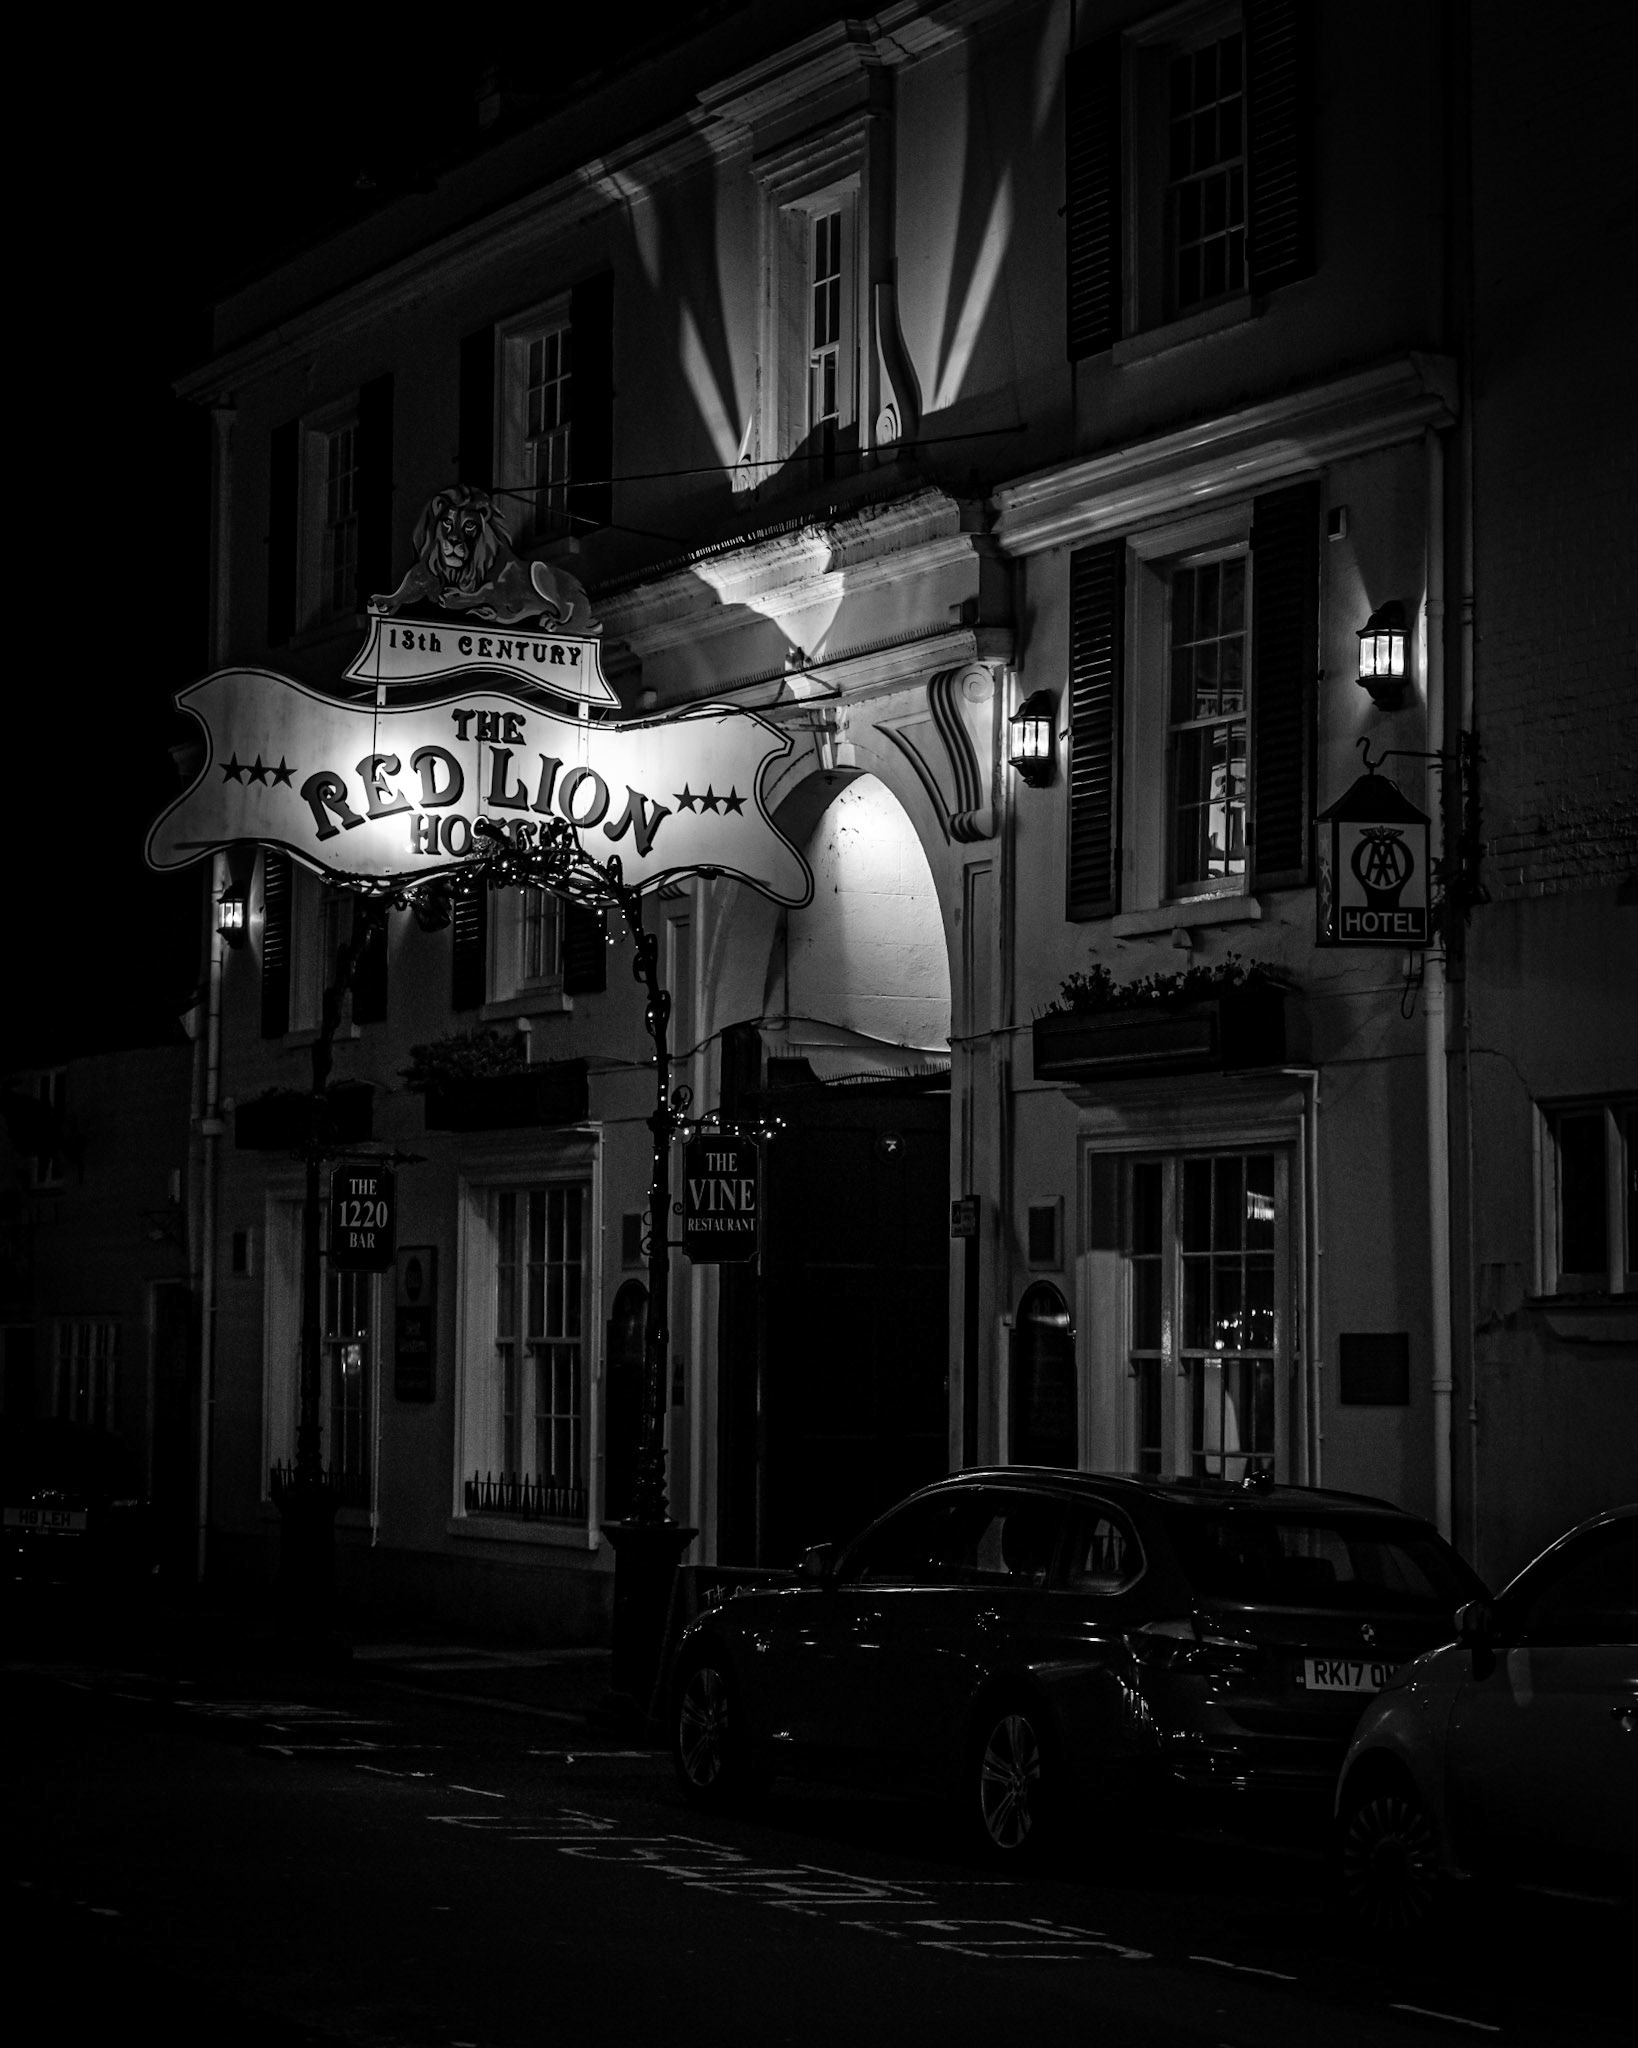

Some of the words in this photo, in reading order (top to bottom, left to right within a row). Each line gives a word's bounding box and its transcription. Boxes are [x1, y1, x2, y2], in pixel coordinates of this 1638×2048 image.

[389, 628, 442, 653] 13th
[458, 635, 582, 666] CENTURY
[451, 708, 527, 745] THE
[300, 745, 465, 841] RED
[487, 745, 673, 858] LION
[1344, 911, 1422, 934] HOTEL
[705, 1152, 738, 1172] THE
[349, 1178, 378, 1196] THE
[688, 1179, 756, 1211] VINE
[338, 1200, 389, 1229] 1220
[687, 1217, 757, 1232] RESTAURANT
[350, 1231, 376, 1249] BAR
[1314, 1661, 1364, 1687] RK17
